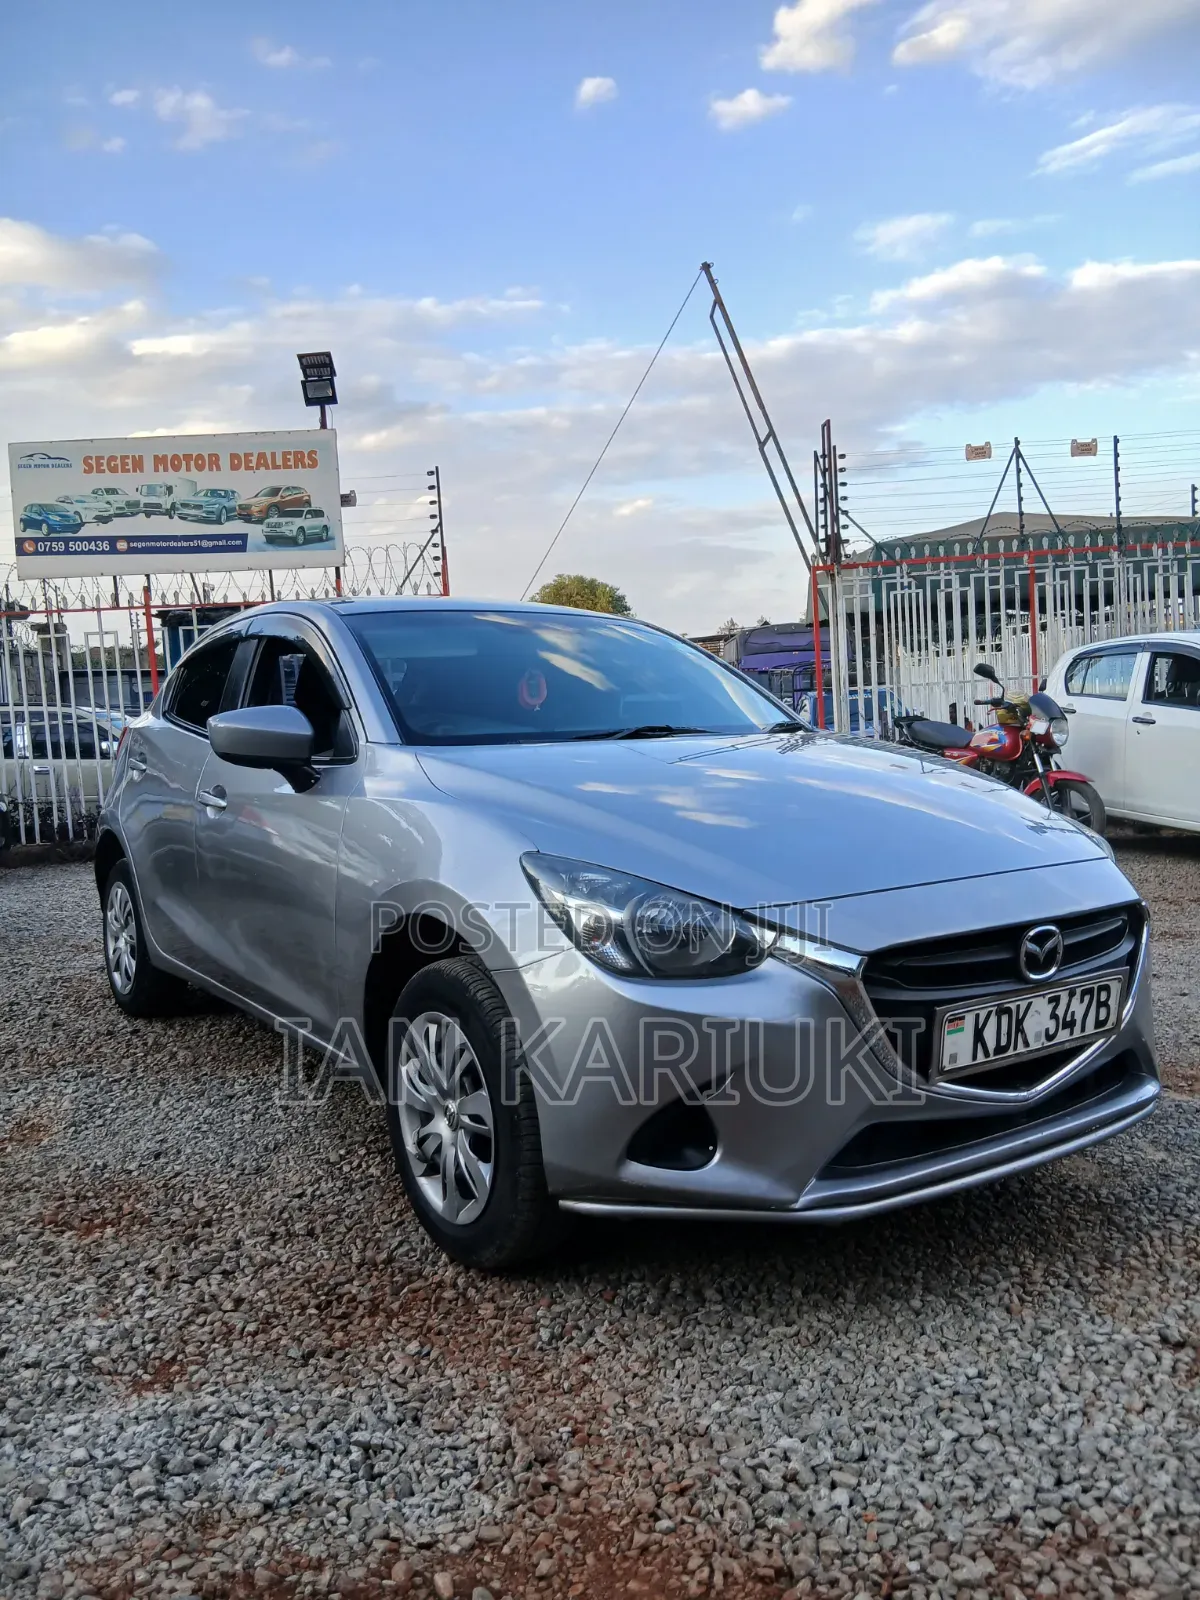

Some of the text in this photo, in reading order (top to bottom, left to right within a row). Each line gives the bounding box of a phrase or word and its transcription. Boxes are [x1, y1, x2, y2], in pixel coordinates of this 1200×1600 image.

[82, 449, 319, 475] SEGEN MOTOR DEALERS
[37, 541, 65, 552] 0759
[68, 541, 110, 552] 500436
[972, 983, 1112, 1062] KDK 347B
